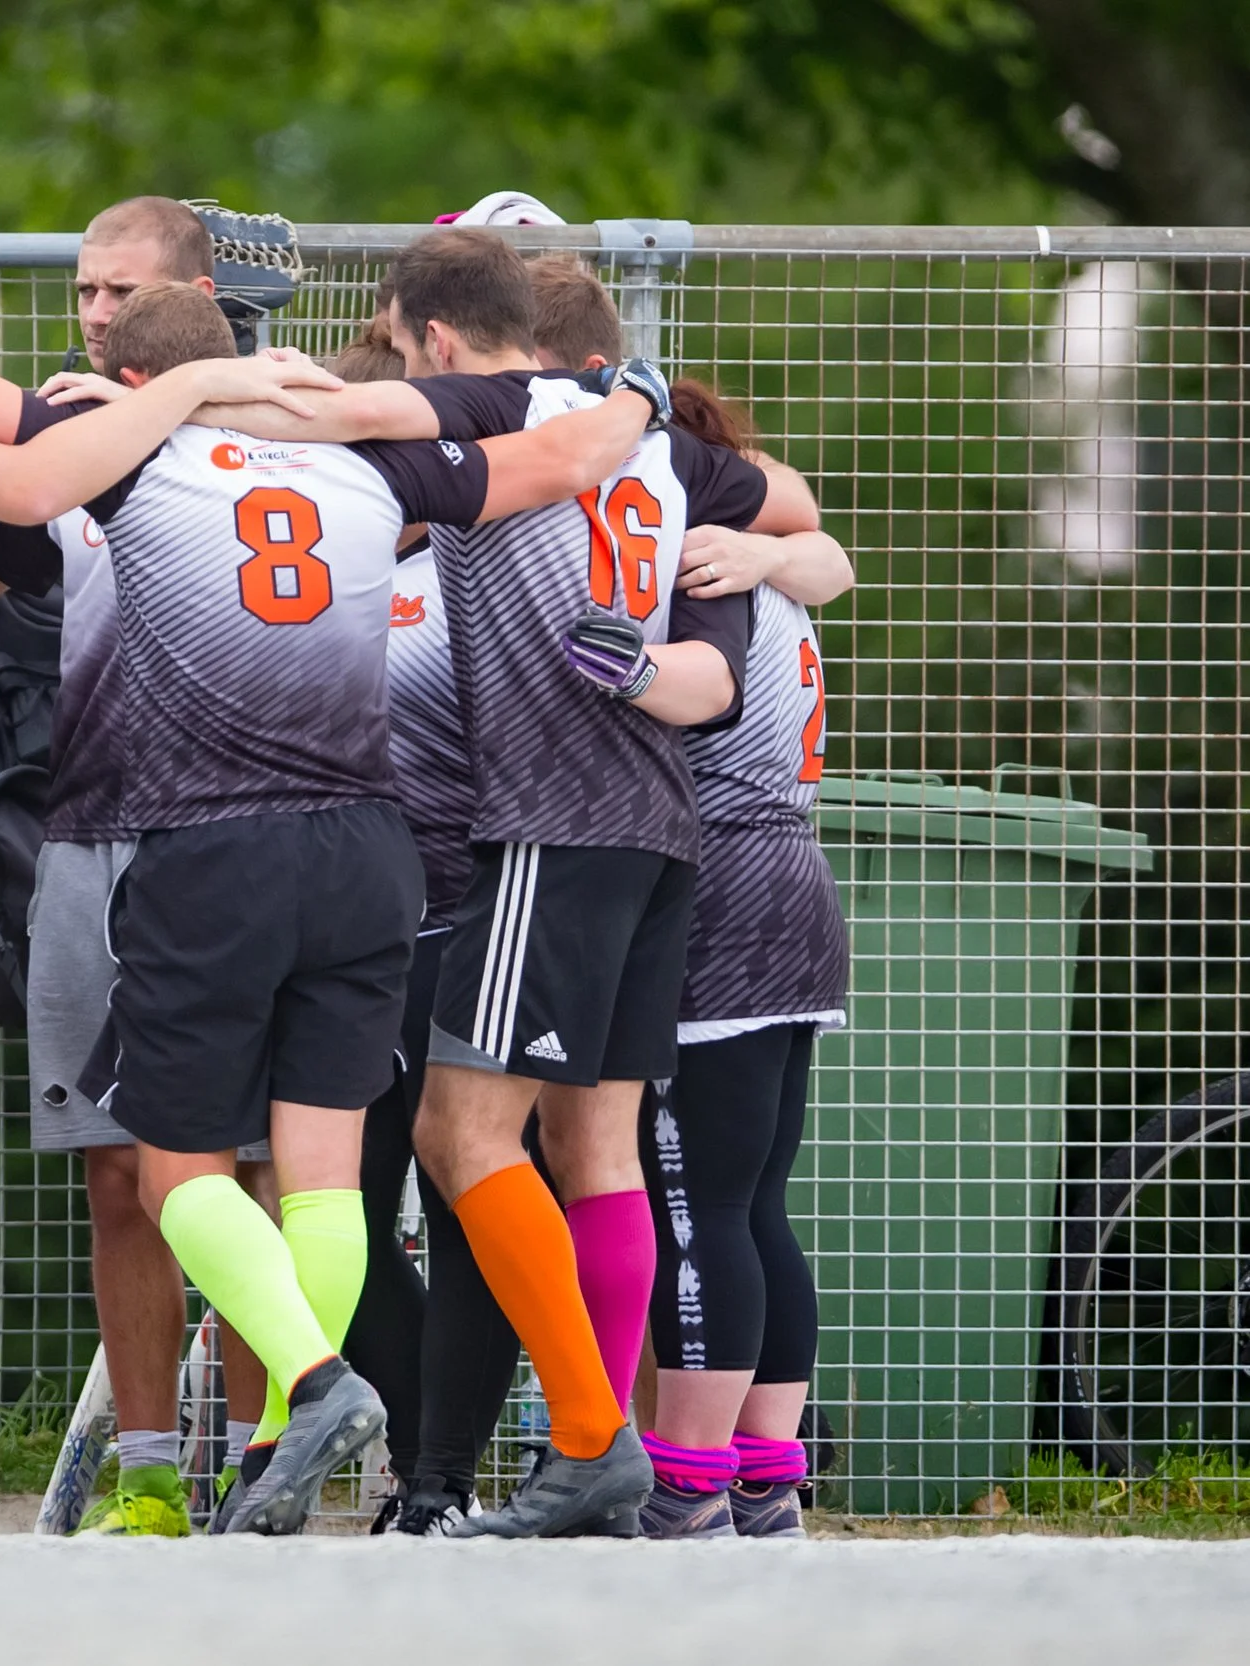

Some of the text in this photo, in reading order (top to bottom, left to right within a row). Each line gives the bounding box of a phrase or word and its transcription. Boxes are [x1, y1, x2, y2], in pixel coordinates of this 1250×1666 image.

[234, 487, 333, 625] 8
[576, 476, 662, 623] 16
[526, 1046, 567, 1062] adidas
